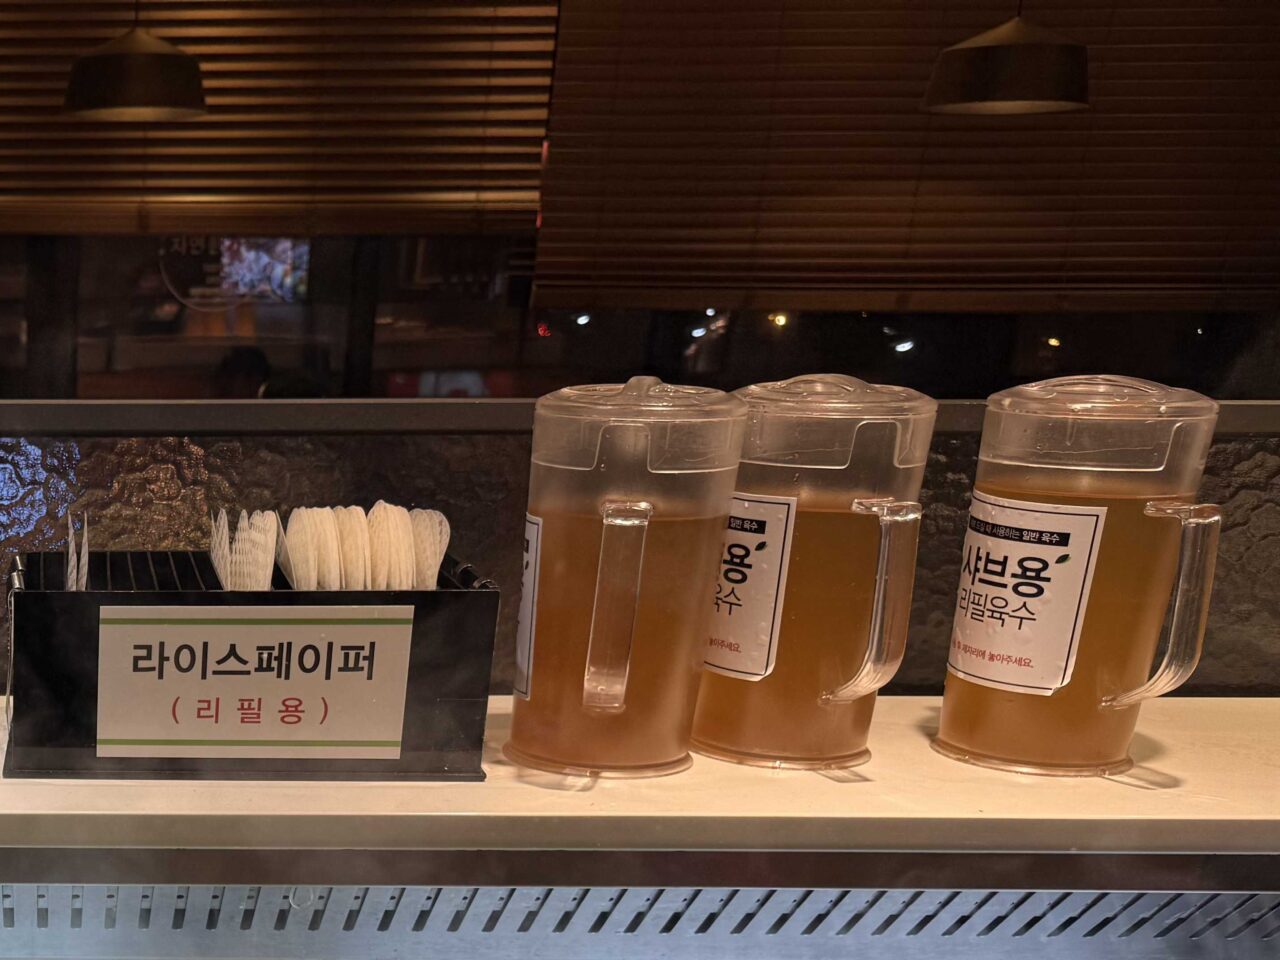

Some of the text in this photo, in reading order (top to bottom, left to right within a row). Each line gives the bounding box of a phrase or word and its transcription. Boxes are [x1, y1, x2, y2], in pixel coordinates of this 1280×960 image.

[1022, 531, 1039, 542] 일반
[1041, 532, 1060, 543] 육수
[718, 543, 752, 584] 용
[963, 545, 1052, 598] 샤브용
[959, 587, 1037, 631] 리필육수
[132, 641, 376, 681] 라이스페이퍼
